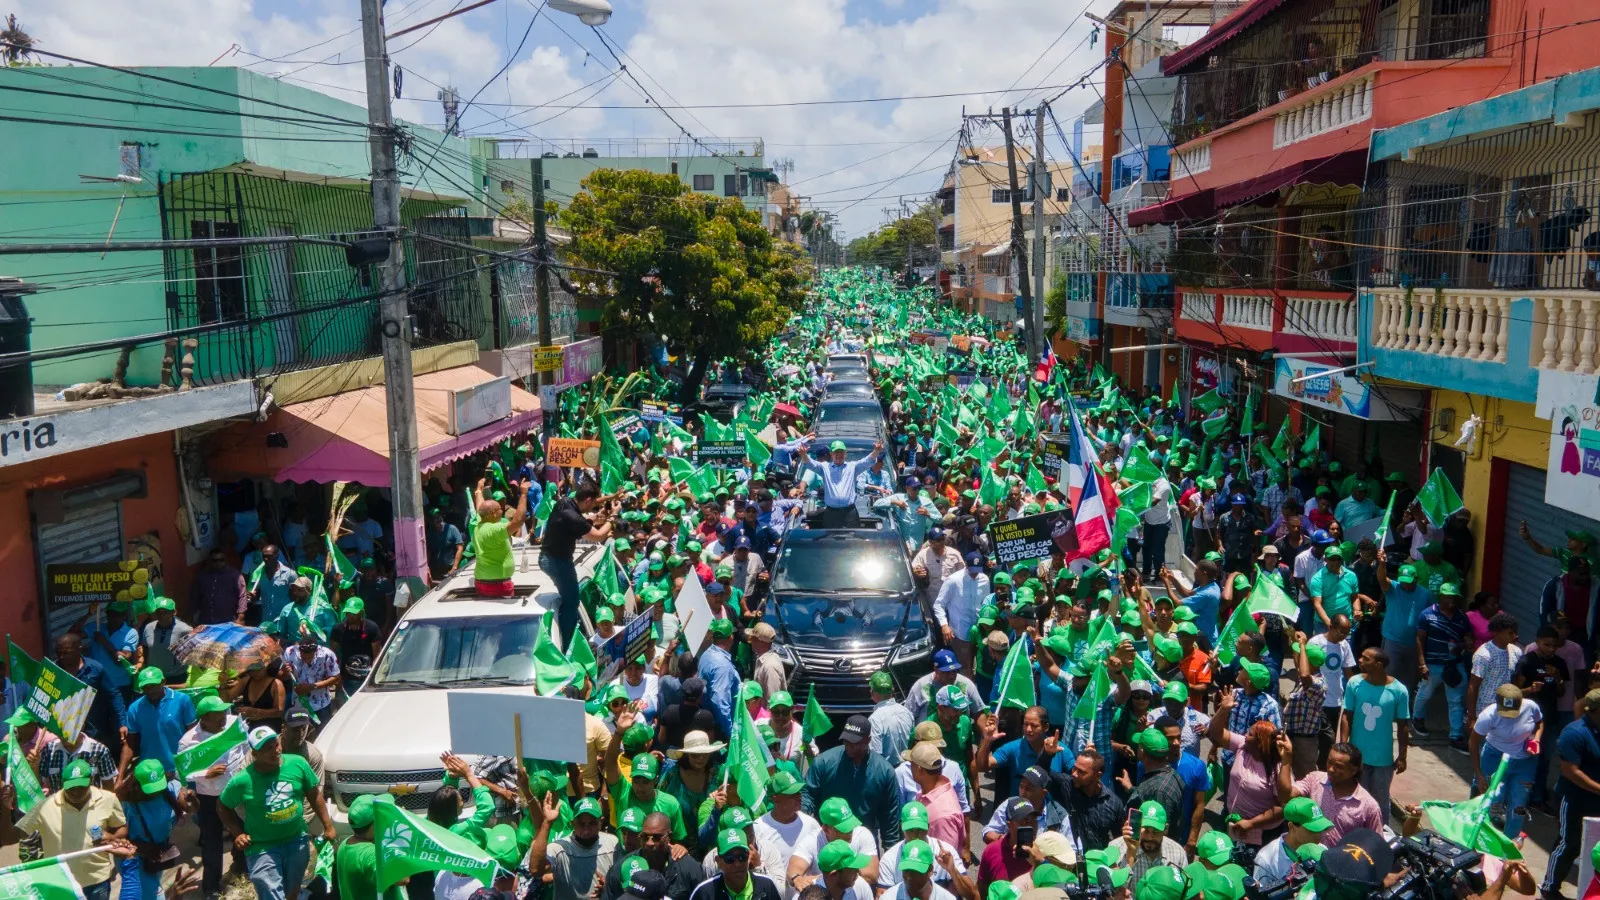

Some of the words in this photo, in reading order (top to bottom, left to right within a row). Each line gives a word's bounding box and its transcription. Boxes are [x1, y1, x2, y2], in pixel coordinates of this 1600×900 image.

[561, 446, 585, 454] CALLE
[994, 526, 998, 534] Y
[1000, 521, 1017, 534] QUIÉN
[1005, 530, 1022, 540] VISTO
[1023, 528, 1035, 537] ESO
[997, 540, 1014, 549] POR
[1015, 538, 1026, 546] UN
[998, 544, 1024, 555] GALÓN
[1037, 540, 1053, 548] GAS
[999, 554, 1016, 563] 148
[1017, 547, 1050, 559] PESOS
[54, 574, 68, 584] NO
[69, 574, 89, 583] HAY
[90, 573, 104, 583] UN
[106, 572, 130, 582] PESO
[71, 583, 85, 593] EN
[85, 582, 113, 592] CALLE
[84, 593, 112, 601] EMPLEOS
[51, 687, 61, 700] ESO
[35, 703, 52, 722] PESOS
[419, 851, 440, 863] DEL
[443, 855, 490, 870] PUEBLO
